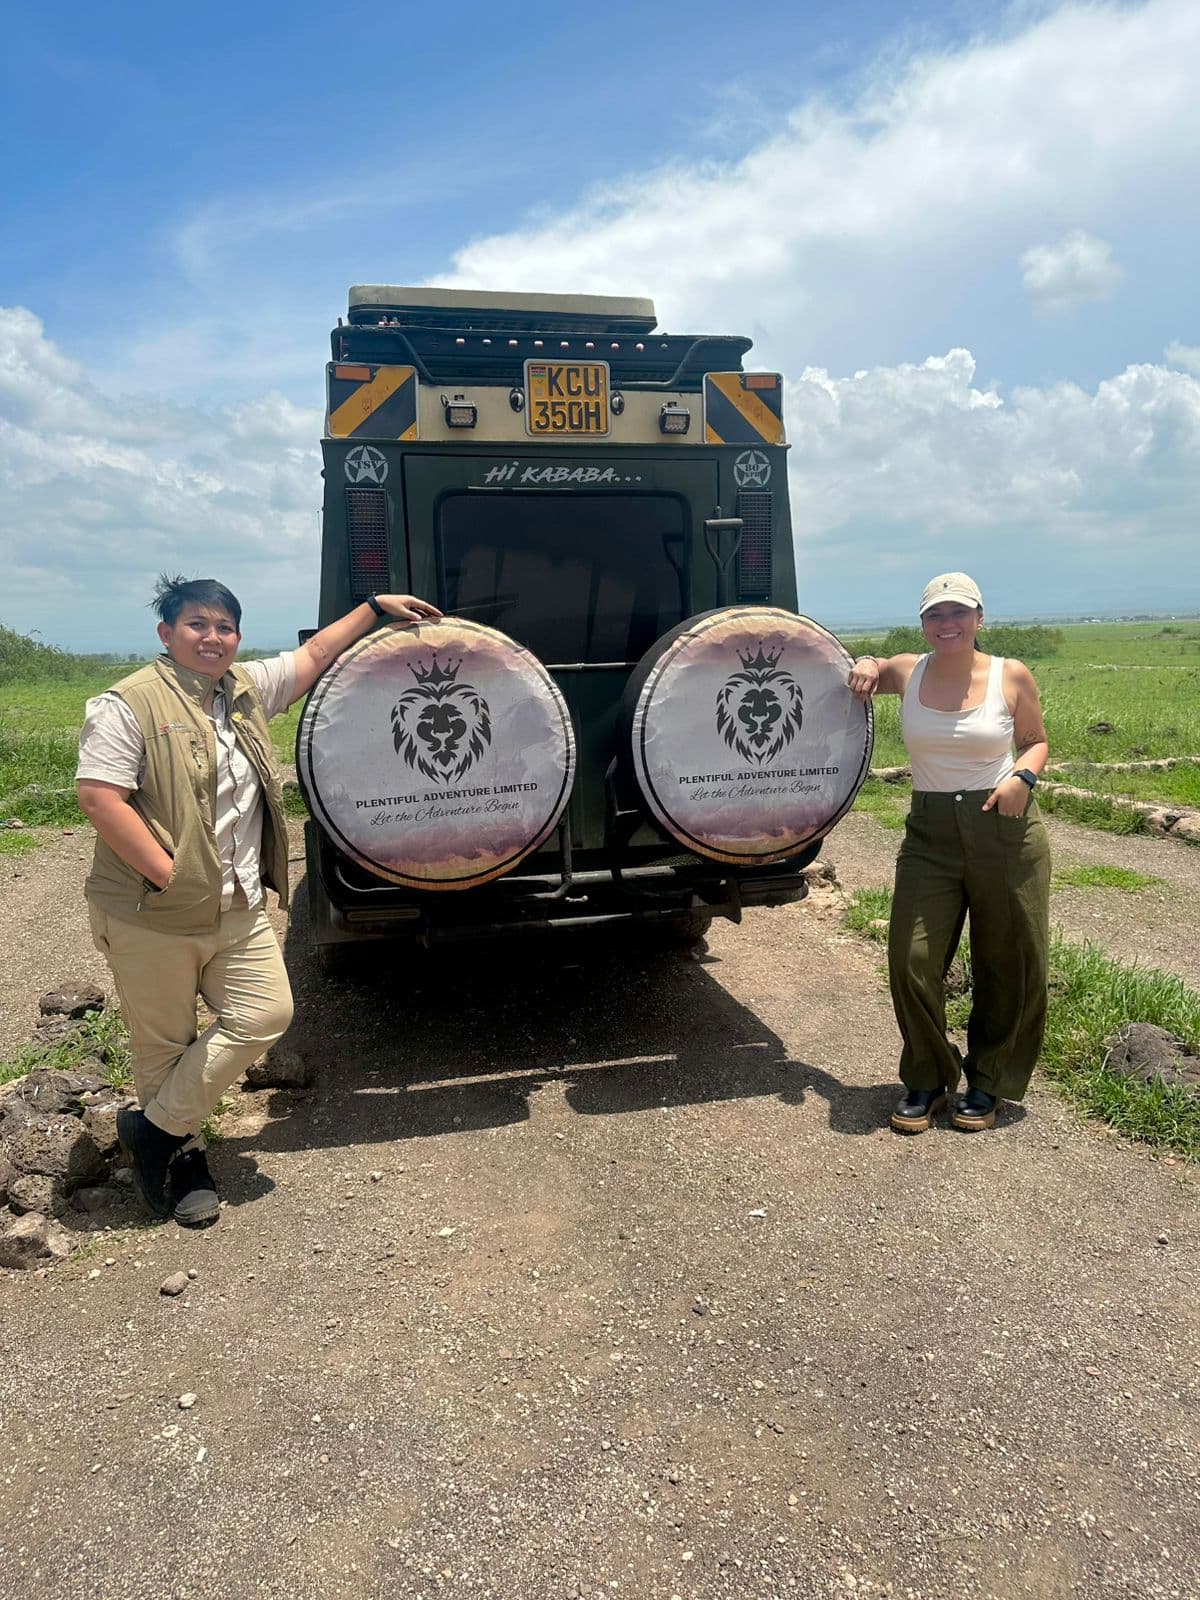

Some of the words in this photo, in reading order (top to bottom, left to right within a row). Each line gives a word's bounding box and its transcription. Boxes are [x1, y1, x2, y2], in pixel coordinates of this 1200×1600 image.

[547, 367, 600, 396] KCU
[535, 401, 601, 430] 350H
[679, 773, 734, 784] PLENTIFUL
[737, 769, 797, 780] ADVENTURE
[799, 766, 839, 777] LIMITED
[356, 795, 420, 809] PLENTIFUL
[423, 787, 491, 801] ADVENTURE
[493, 782, 538, 794] LIMITED
[690, 787, 711, 801] Let
[711, 788, 727, 799] the
[728, 784, 787, 799] Adventure
[789, 780, 821, 795] Begin
[370, 811, 393, 826] Let
[394, 811, 412, 822] the
[415, 805, 482, 822] Adventure
[483, 798, 520, 815] Begin
